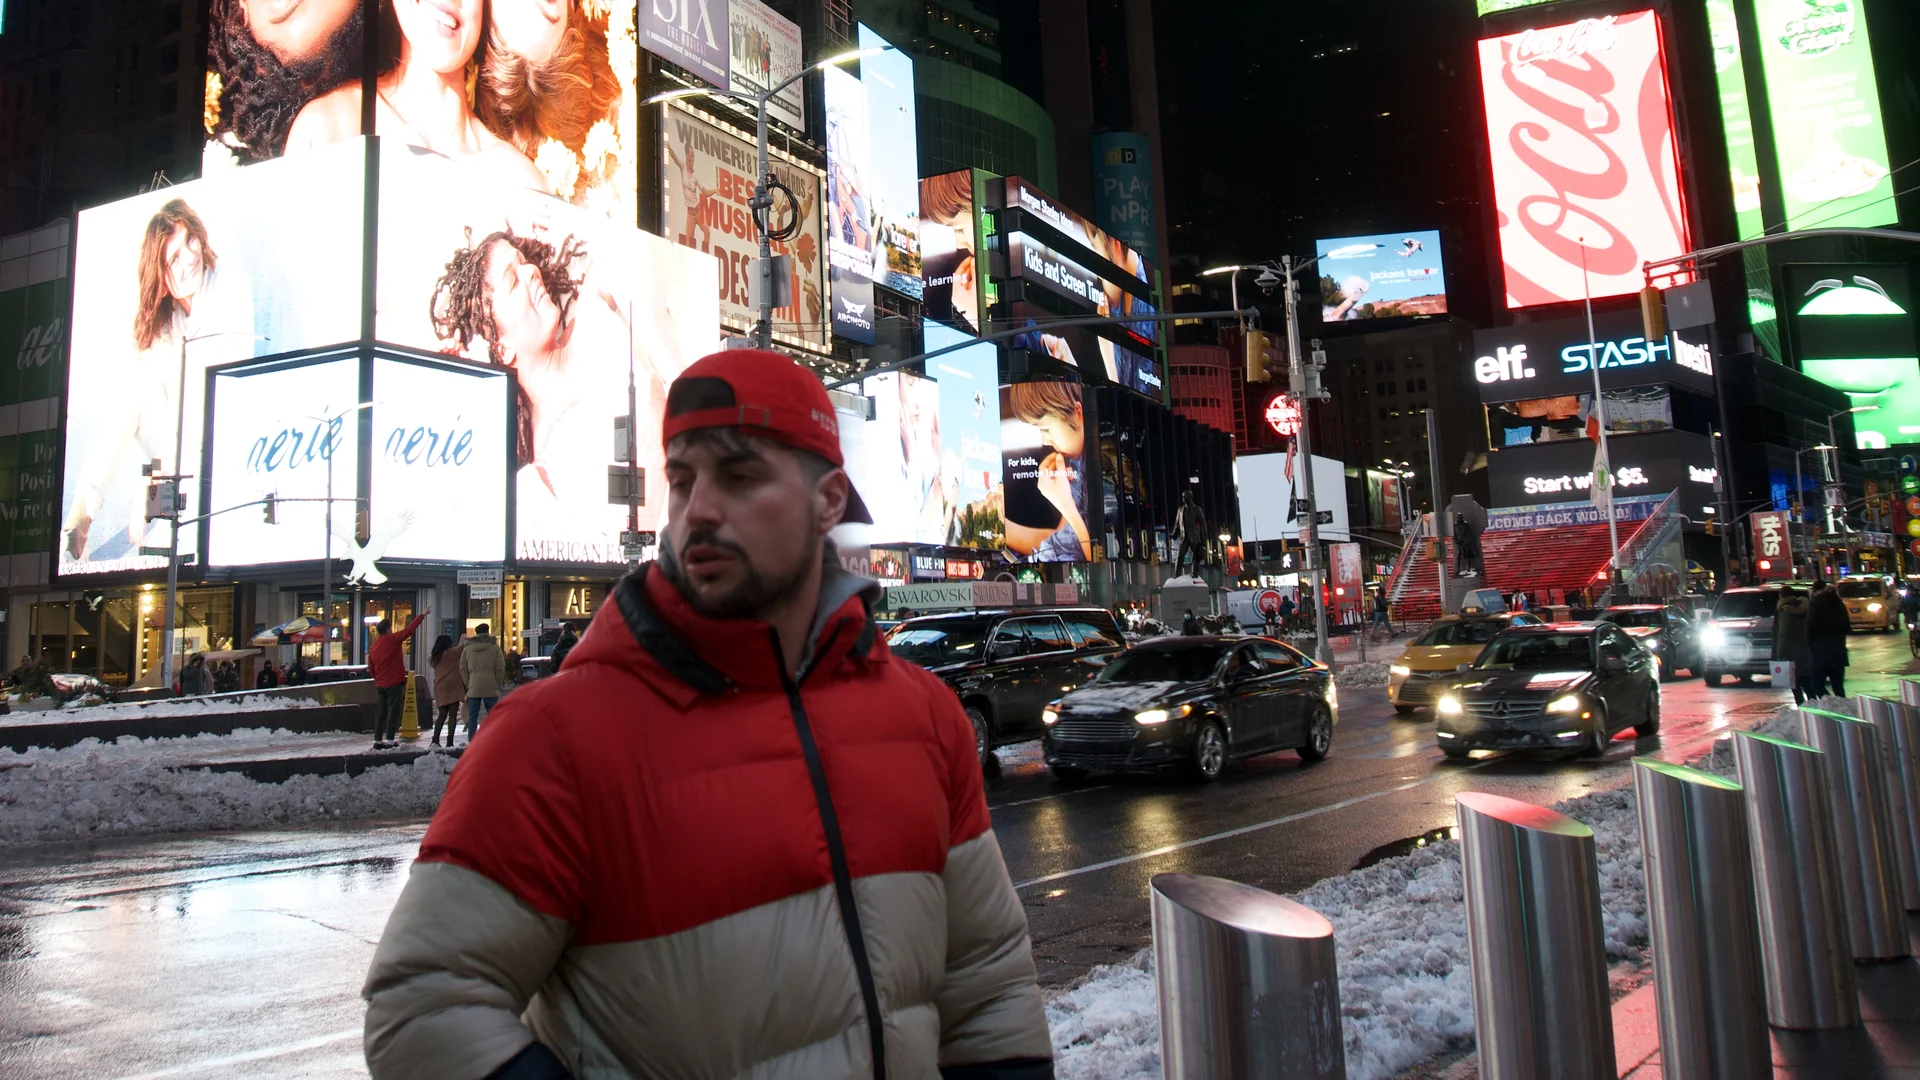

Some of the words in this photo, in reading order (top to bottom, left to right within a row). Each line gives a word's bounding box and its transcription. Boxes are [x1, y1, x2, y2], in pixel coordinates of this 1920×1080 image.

[667, 25, 679, 41] THE
[681, 30, 707, 57] MUSICAL
[783, 43, 798, 62] PLAY
[675, 118, 746, 172] WINNER!
[746, 153, 753, 175] 8
[775, 165, 807, 199] AWARDS
[719, 166, 757, 207] BES
[1020, 185, 1041, 210] Morgan
[1041, 199, 1060, 224] Stanley
[928, 272, 968, 287] learning
[1024, 245, 1043, 275] Kids
[1044, 262, 1059, 284] and
[1060, 265, 1087, 298] Screen
[1086, 279, 1105, 307] Time
[1369, 269, 1405, 282] jackass
[837, 312, 871, 330] ARCIMOTO
[1560, 335, 1672, 374] STASH
[247, 405, 344, 475] aerie
[382, 414, 474, 468] aerie
[1007, 458, 1019, 468] For
[1019, 456, 1038, 468] kids,
[1012, 470, 1043, 480] remote
[1523, 476, 1573, 494] Start
[1573, 470, 1616, 490] wih
[1617, 466, 1649, 487] $5.
[1486, 516, 1533, 531] LCOME
[1536, 511, 1573, 527] BACK
[1574, 507, 1629, 522] WORD!
[1759, 515, 1784, 557] tkts
[519, 539, 602, 563] AMERICAN
[916, 556, 932, 570] BLUE
[565, 588, 592, 615] AE
[888, 588, 972, 605] SWAROVSKI
[973, 585, 1012, 603] SWAROVSKI
